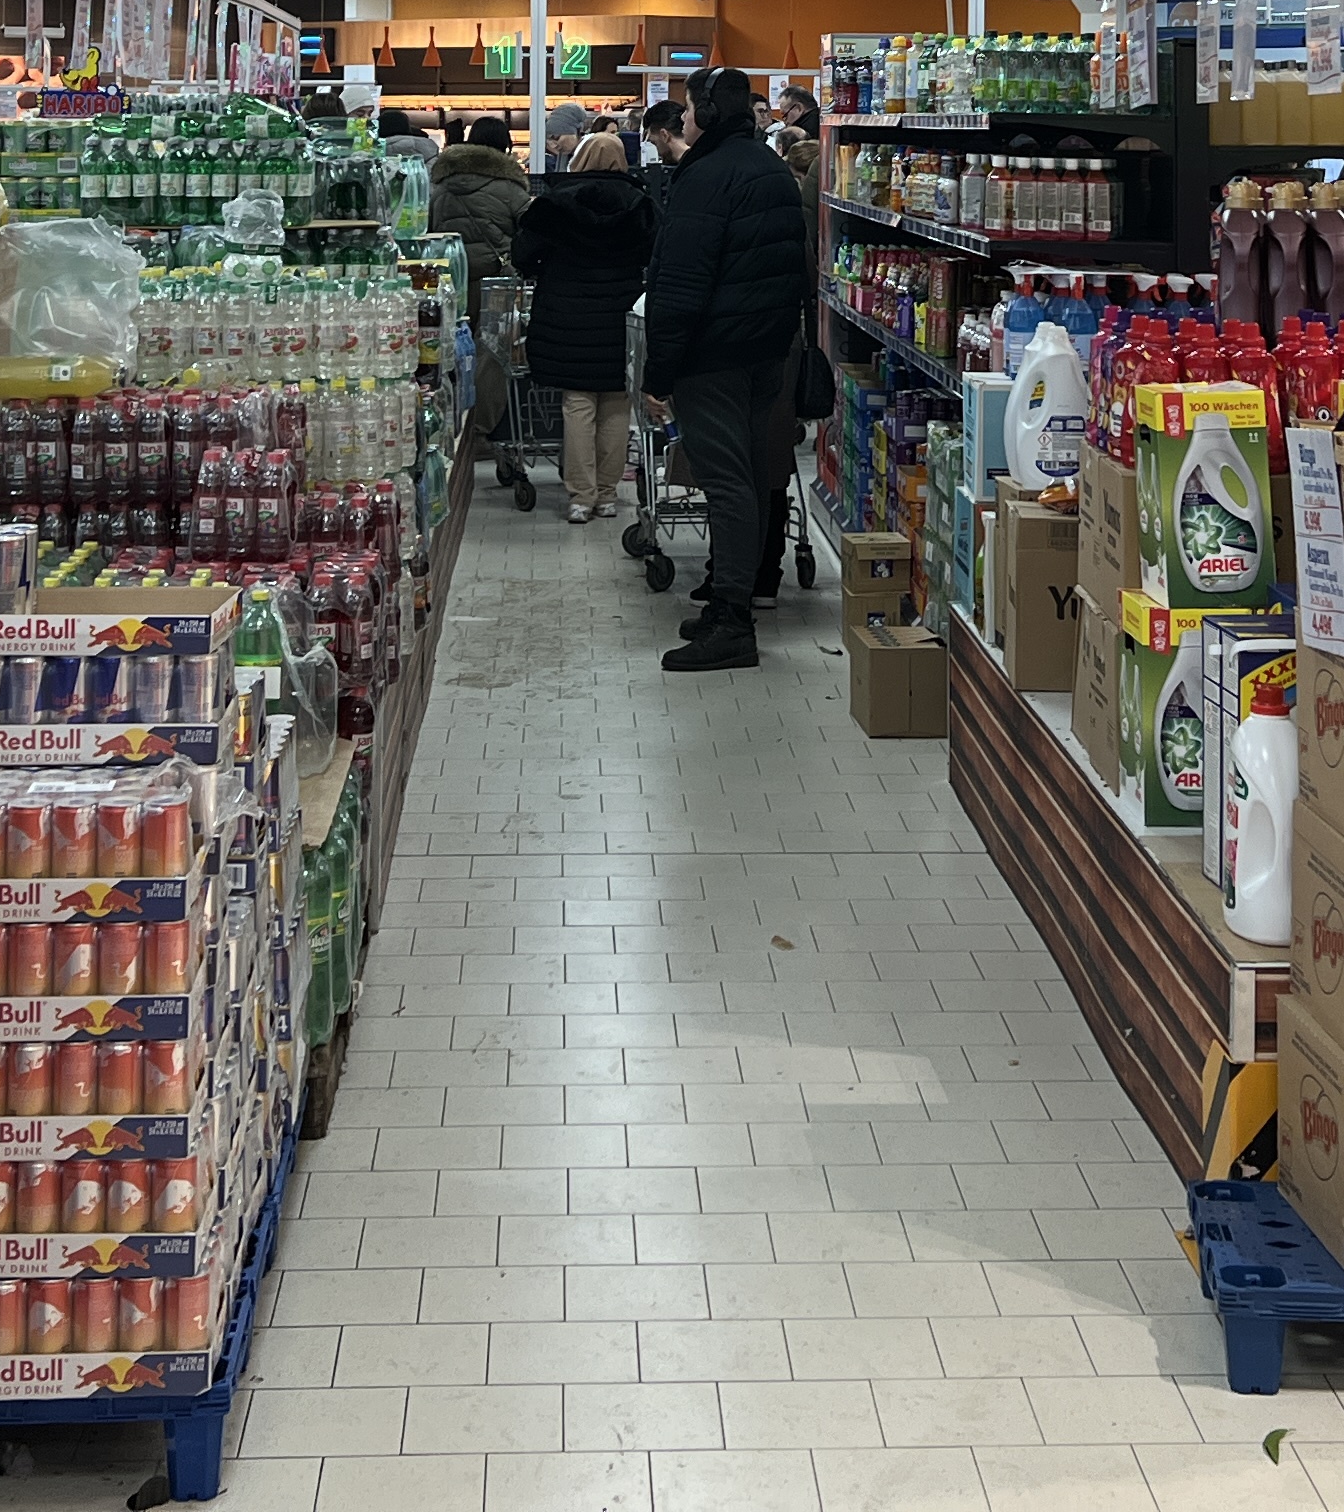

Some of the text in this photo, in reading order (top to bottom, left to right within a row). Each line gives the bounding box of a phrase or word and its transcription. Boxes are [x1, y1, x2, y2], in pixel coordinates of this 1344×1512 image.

[491, 36, 513, 75] 1
[561, 35, 591, 76] 2
[43, 93, 122, 115] HARIBO
[1189, 401, 1259, 412] 100 Wäschen
[1198, 558, 1250, 573] ARIEL
[36, 618, 76, 639] Bull
[1176, 618, 1196, 628] 100
[41, 642, 76, 652] DRINK
[41, 729, 82, 749] Bull
[46, 753, 82, 763] DRINK
[1, 909, 41, 918] DRINK
[1, 1027, 41, 1037] DRINK
[1301, 1094, 1339, 1145] Bingo
[3, 1147, 42, 1156] DRINK
[5, 1239, 48, 1260] Bull
[9, 1264, 48, 1273] DRINK
[19, 1360, 63, 1381] Bull
[22, 1386, 63, 1395] DRINK
